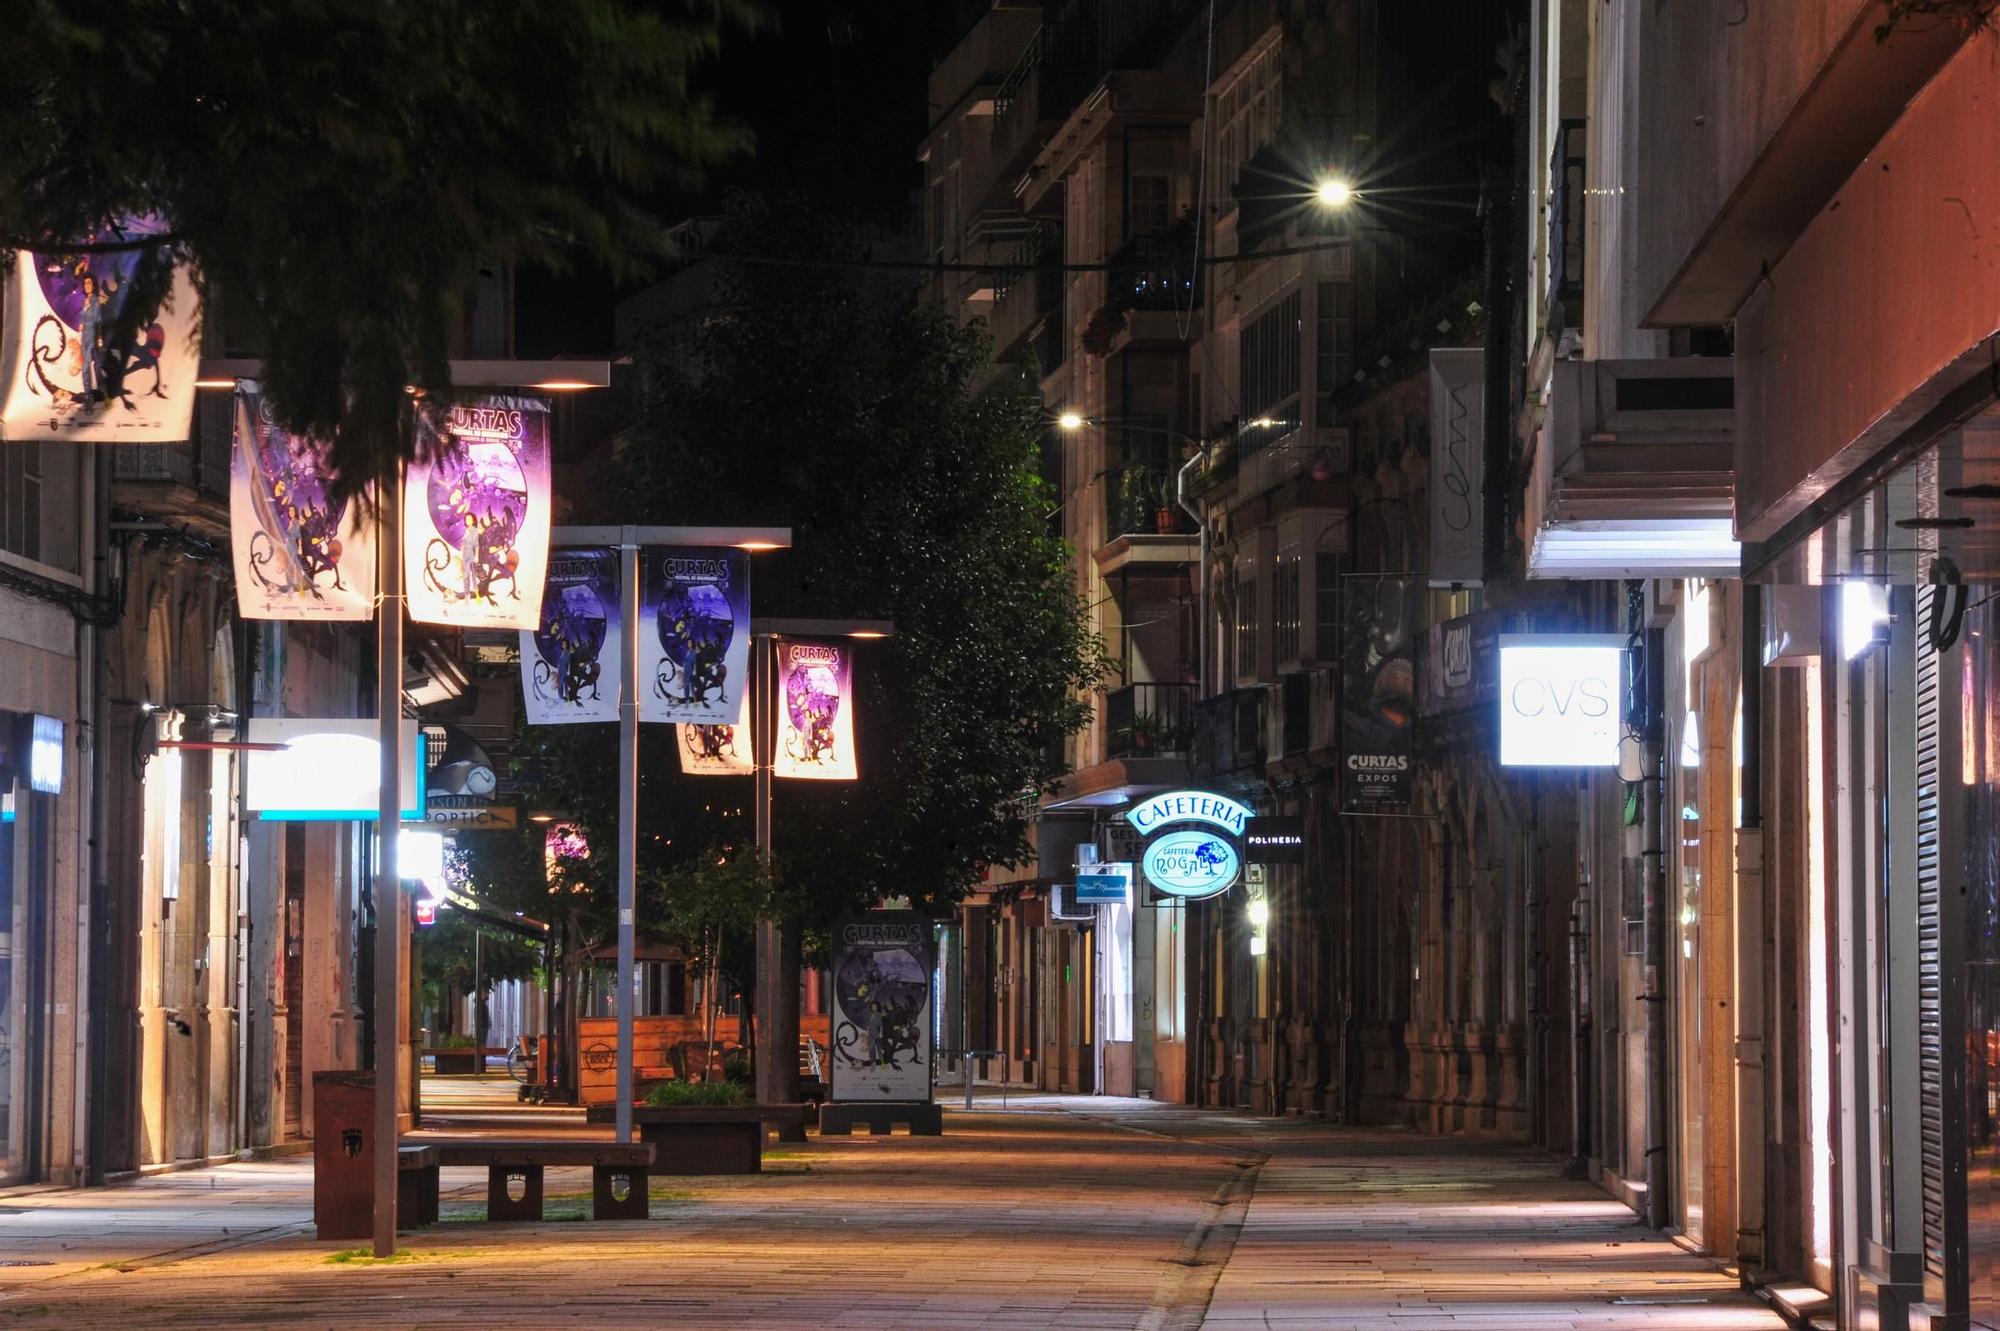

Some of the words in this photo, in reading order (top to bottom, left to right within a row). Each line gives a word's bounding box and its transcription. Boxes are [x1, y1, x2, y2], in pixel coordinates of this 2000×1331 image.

[443, 407, 523, 439] URTAS
[547, 559, 600, 580] URTAS
[663, 558, 730, 581] CURTAS
[790, 645, 839, 665] CURTAS
[1347, 754, 1408, 771] CURTAS
[1357, 774, 1398, 783] EXPOS
[1136, 797, 1244, 829] CAFETERIA
[1248, 836, 1302, 845] POLINESIA
[1163, 847, 1195, 856] CAFETERIA
[843, 924, 921, 945] CURTAS
